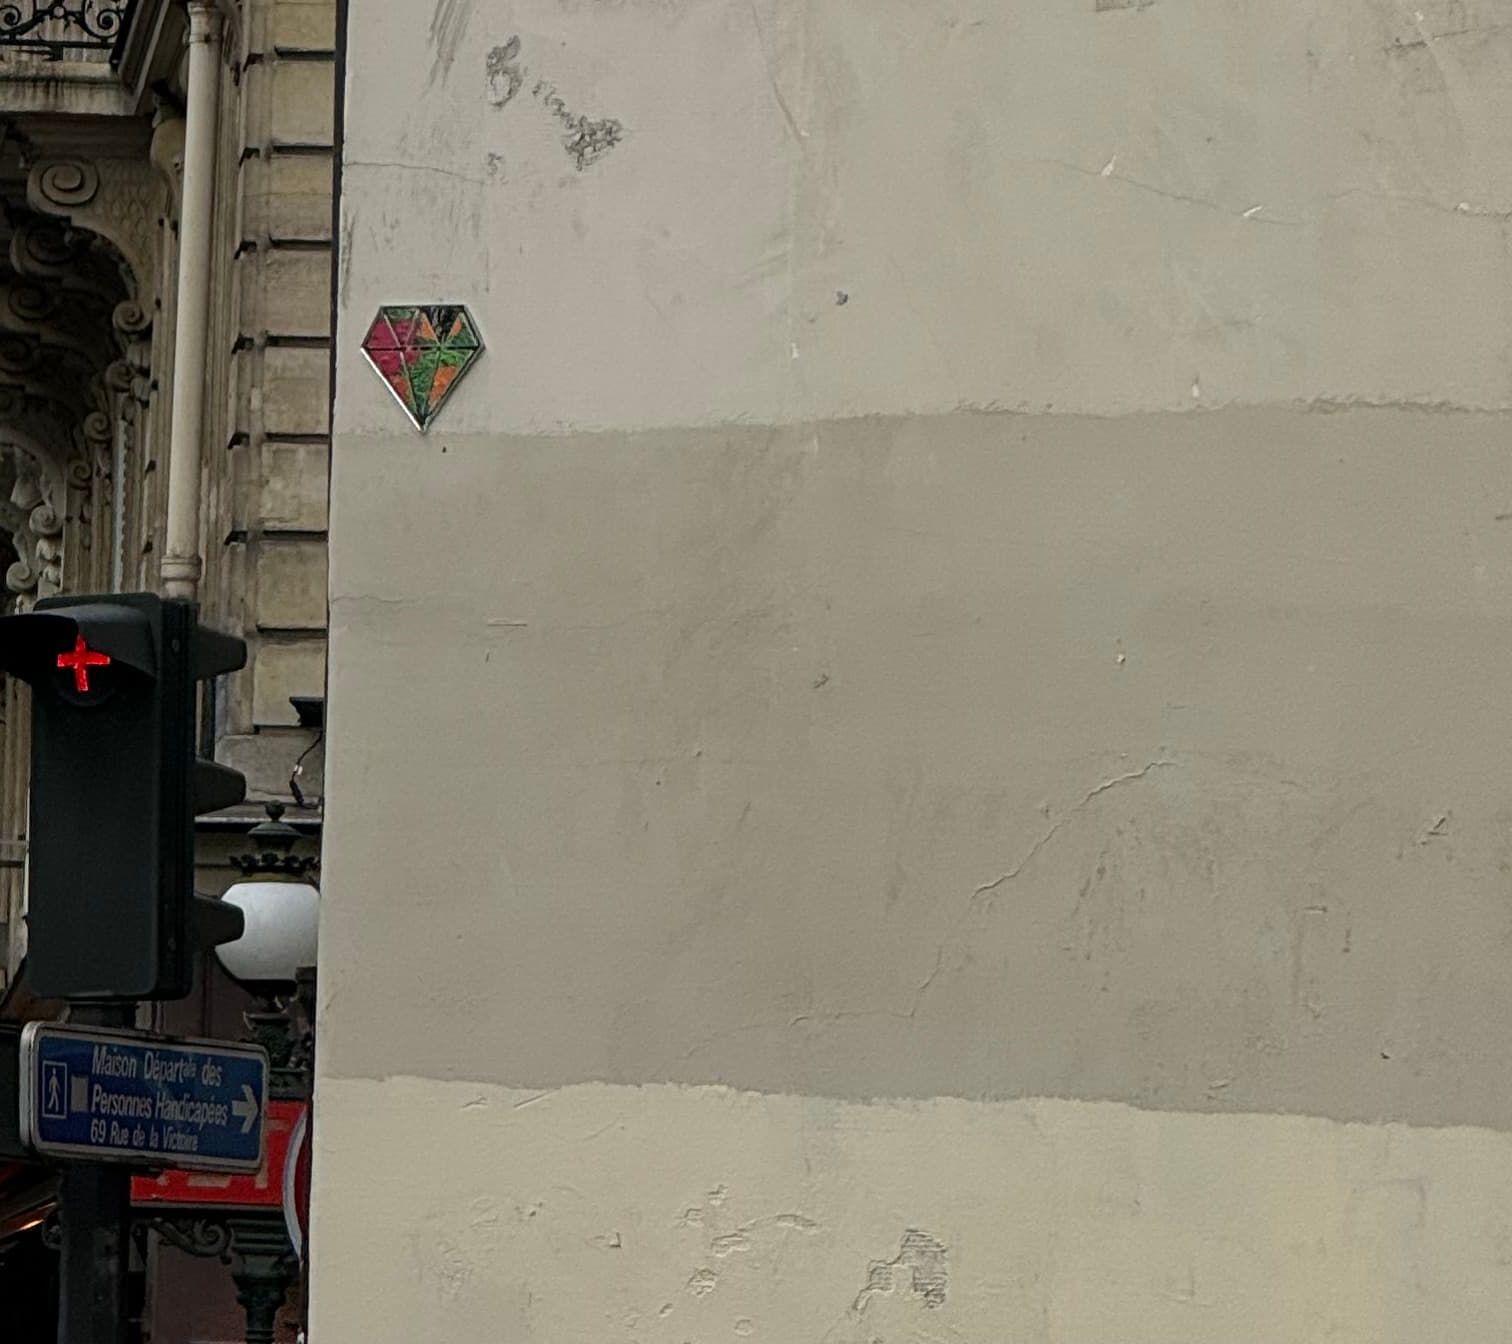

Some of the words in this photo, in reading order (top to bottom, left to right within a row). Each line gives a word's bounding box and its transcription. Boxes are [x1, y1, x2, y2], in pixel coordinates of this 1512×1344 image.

[91, 1045, 137, 1079] Maison
[201, 1056, 224, 1088] des
[91, 1083, 153, 1120] Personnes
[154, 1090, 230, 1131] Handicapées
[90, 1118, 108, 1144] 69
[109, 1120, 131, 1146] Rue
[132, 1123, 146, 1148] de
[149, 1124, 160, 1149] la
